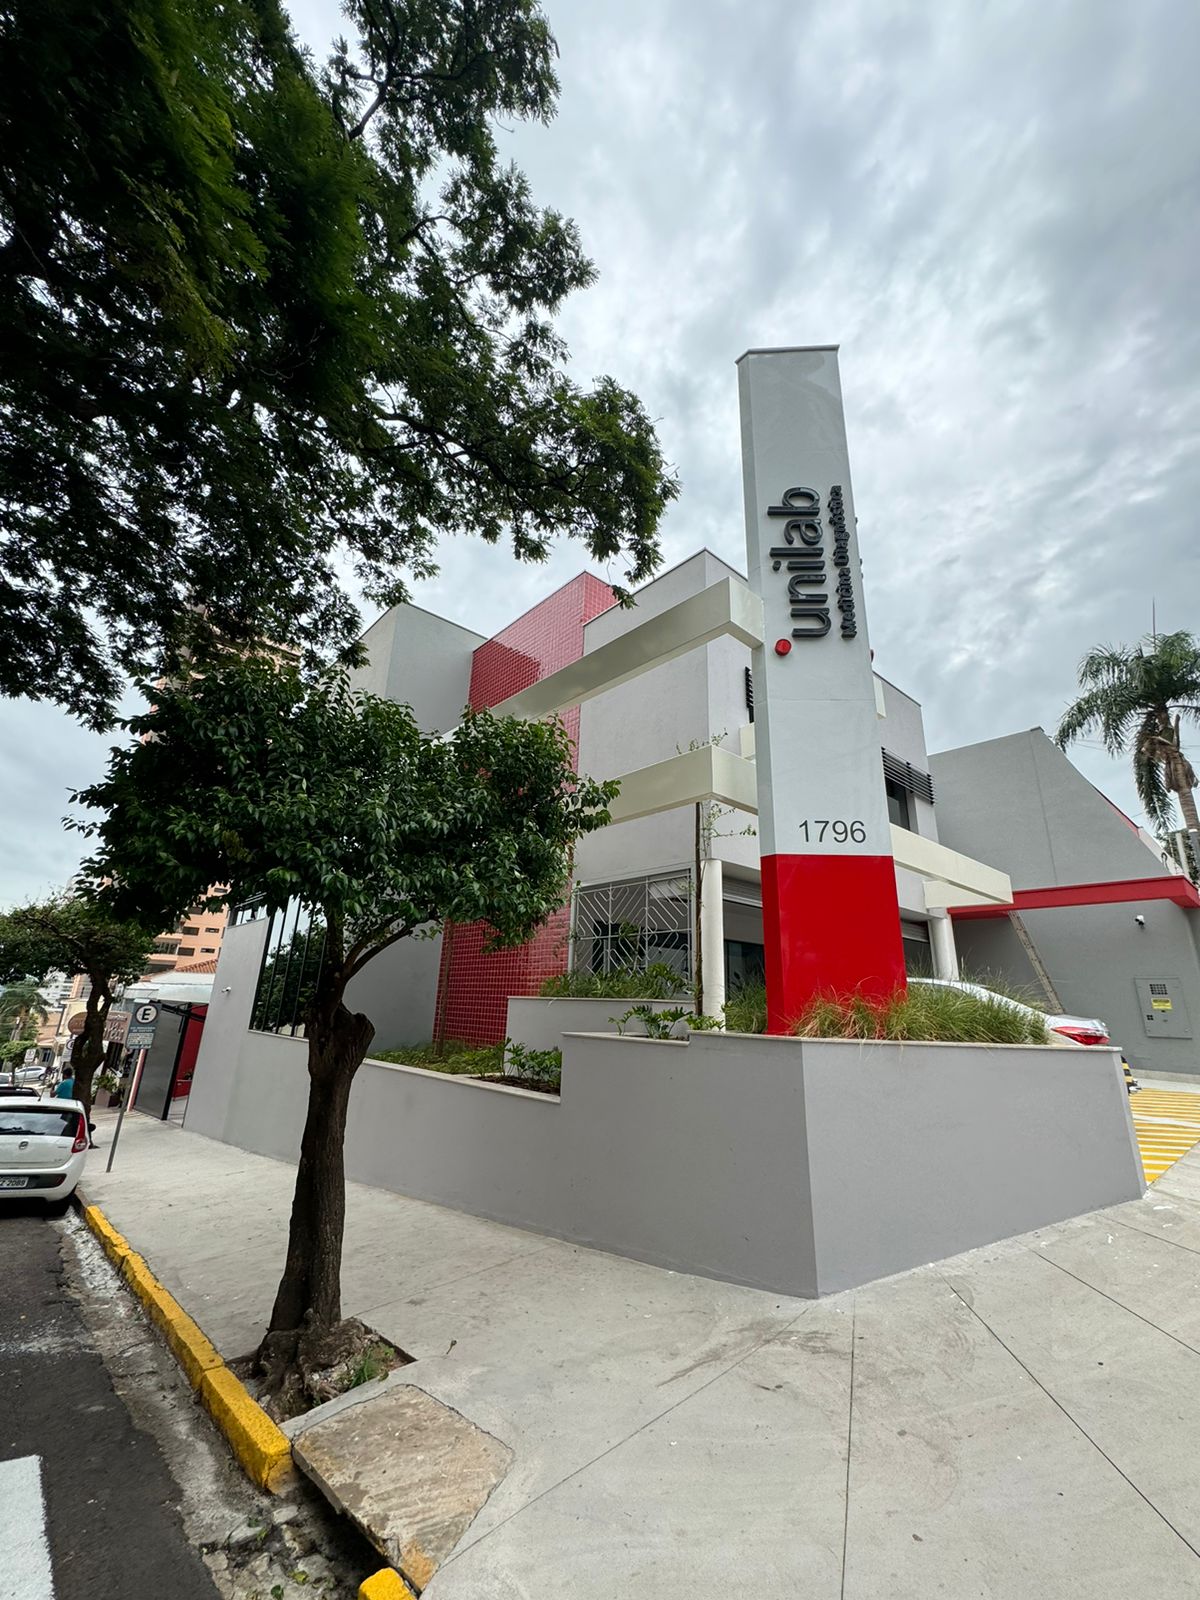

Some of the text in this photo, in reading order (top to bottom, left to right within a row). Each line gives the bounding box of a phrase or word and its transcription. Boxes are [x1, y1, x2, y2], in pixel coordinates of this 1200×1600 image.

[767, 487, 831, 638] unilab
[827, 485, 857, 640] Medicina Diagnóstica
[799, 819, 866, 843] 1796
[141, 1008, 152, 1021] E
